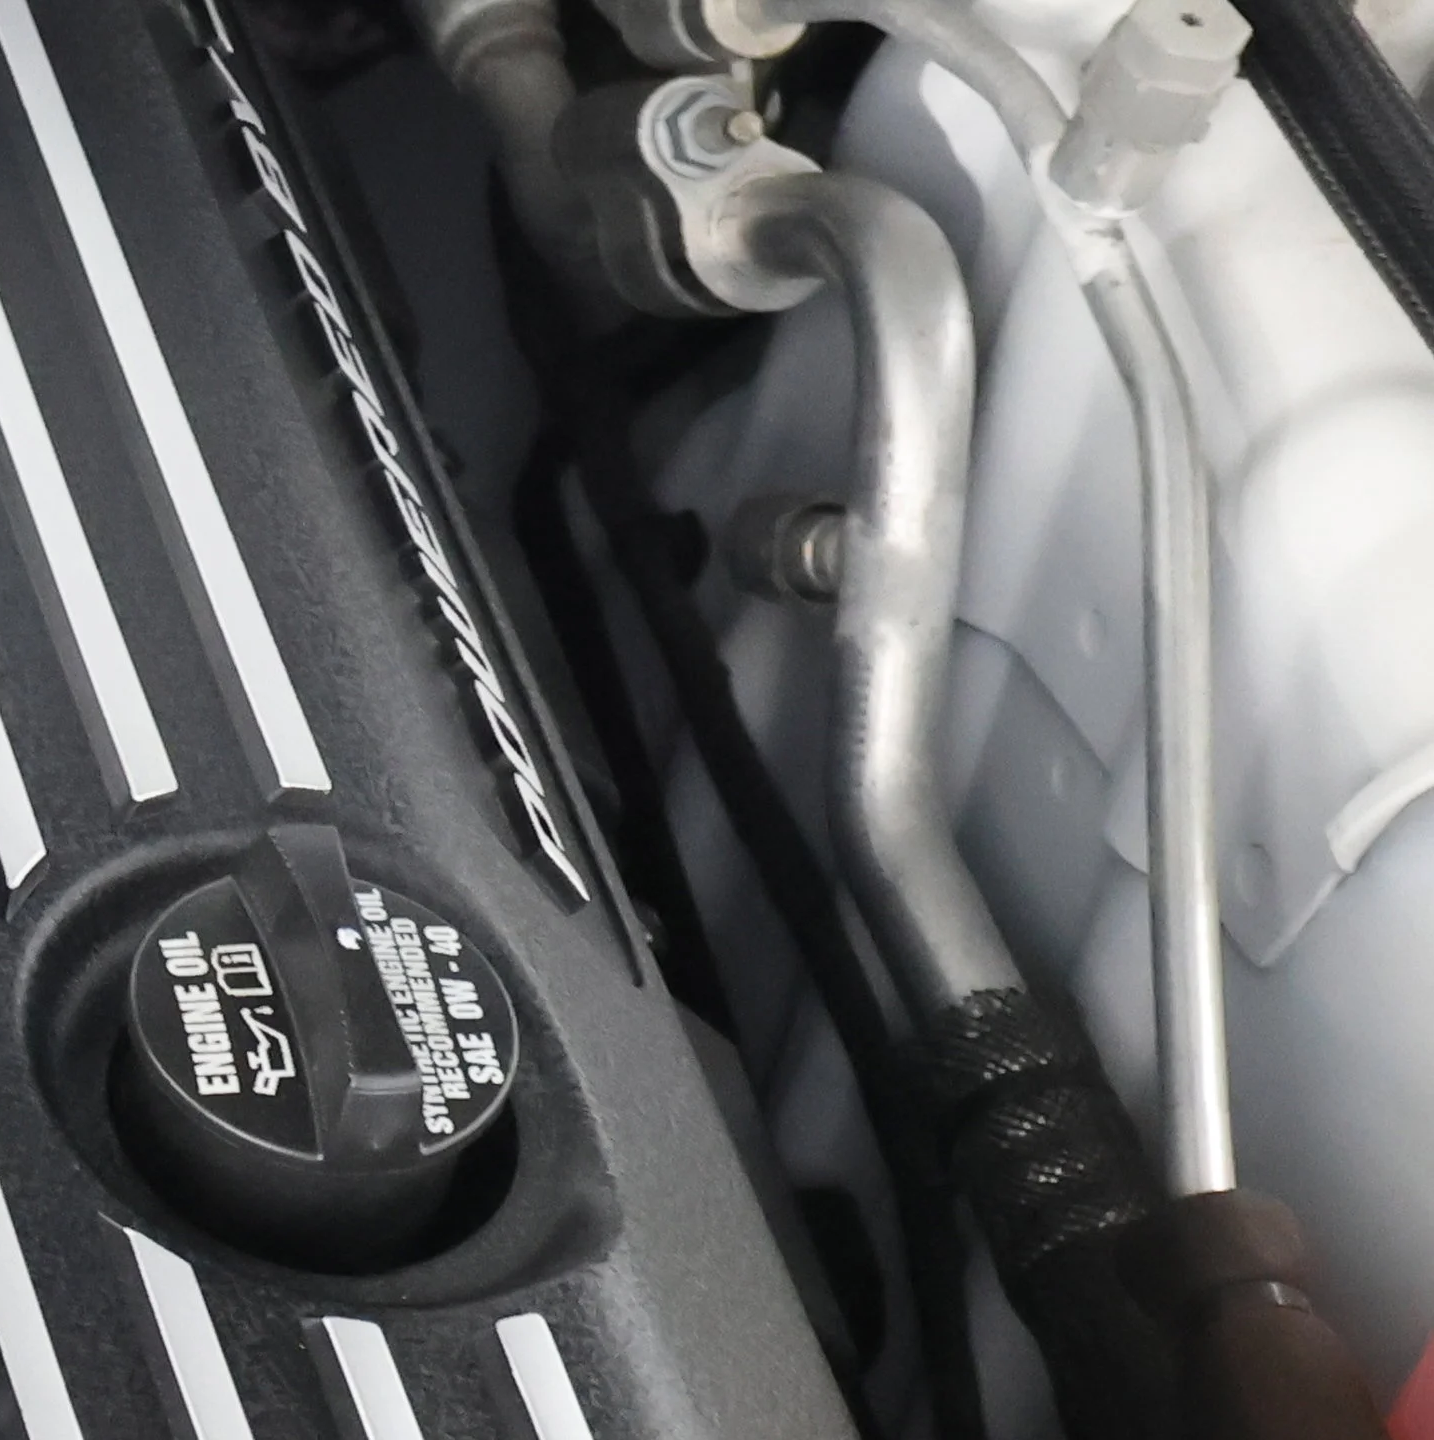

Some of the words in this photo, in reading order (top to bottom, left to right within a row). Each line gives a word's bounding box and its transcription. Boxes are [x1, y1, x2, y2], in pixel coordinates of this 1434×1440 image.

[207, 46, 307, 233] BY
[284, 229, 591, 902] POWERED
[158, 930, 209, 977] OIL
[354, 887, 388, 922] OIL
[366, 922, 415, 1005] ENGINE
[390, 917, 471, 1099] RECOMMENDED
[173, 982, 241, 1096] ENGINE
[456, 1032, 505, 1085] SAE
